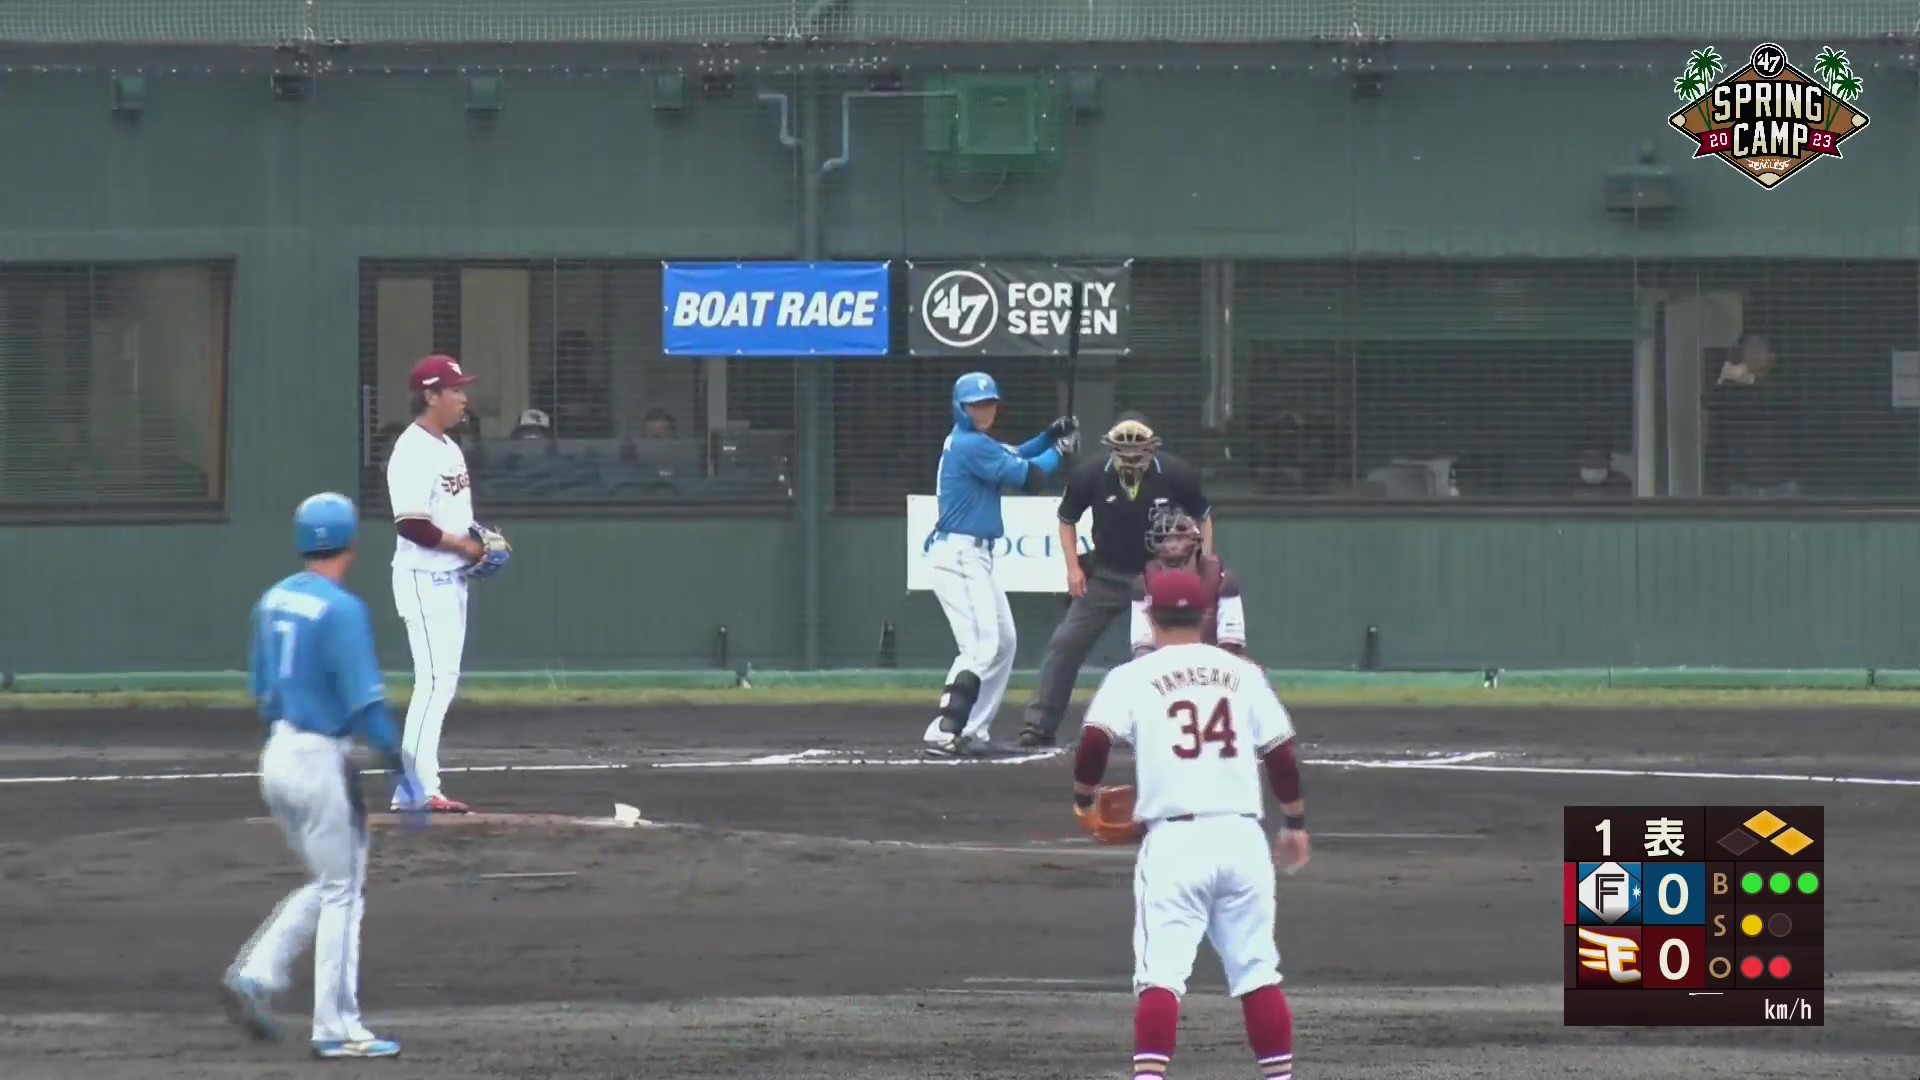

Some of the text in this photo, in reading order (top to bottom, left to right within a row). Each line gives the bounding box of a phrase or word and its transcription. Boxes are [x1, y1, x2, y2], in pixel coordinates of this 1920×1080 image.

[673, 290, 879, 327] BOAT RACE
[1007, 281, 1117, 309] FORTY
[1007, 309, 1118, 336] SEVEN
[1167, 696, 1239, 760] 34
